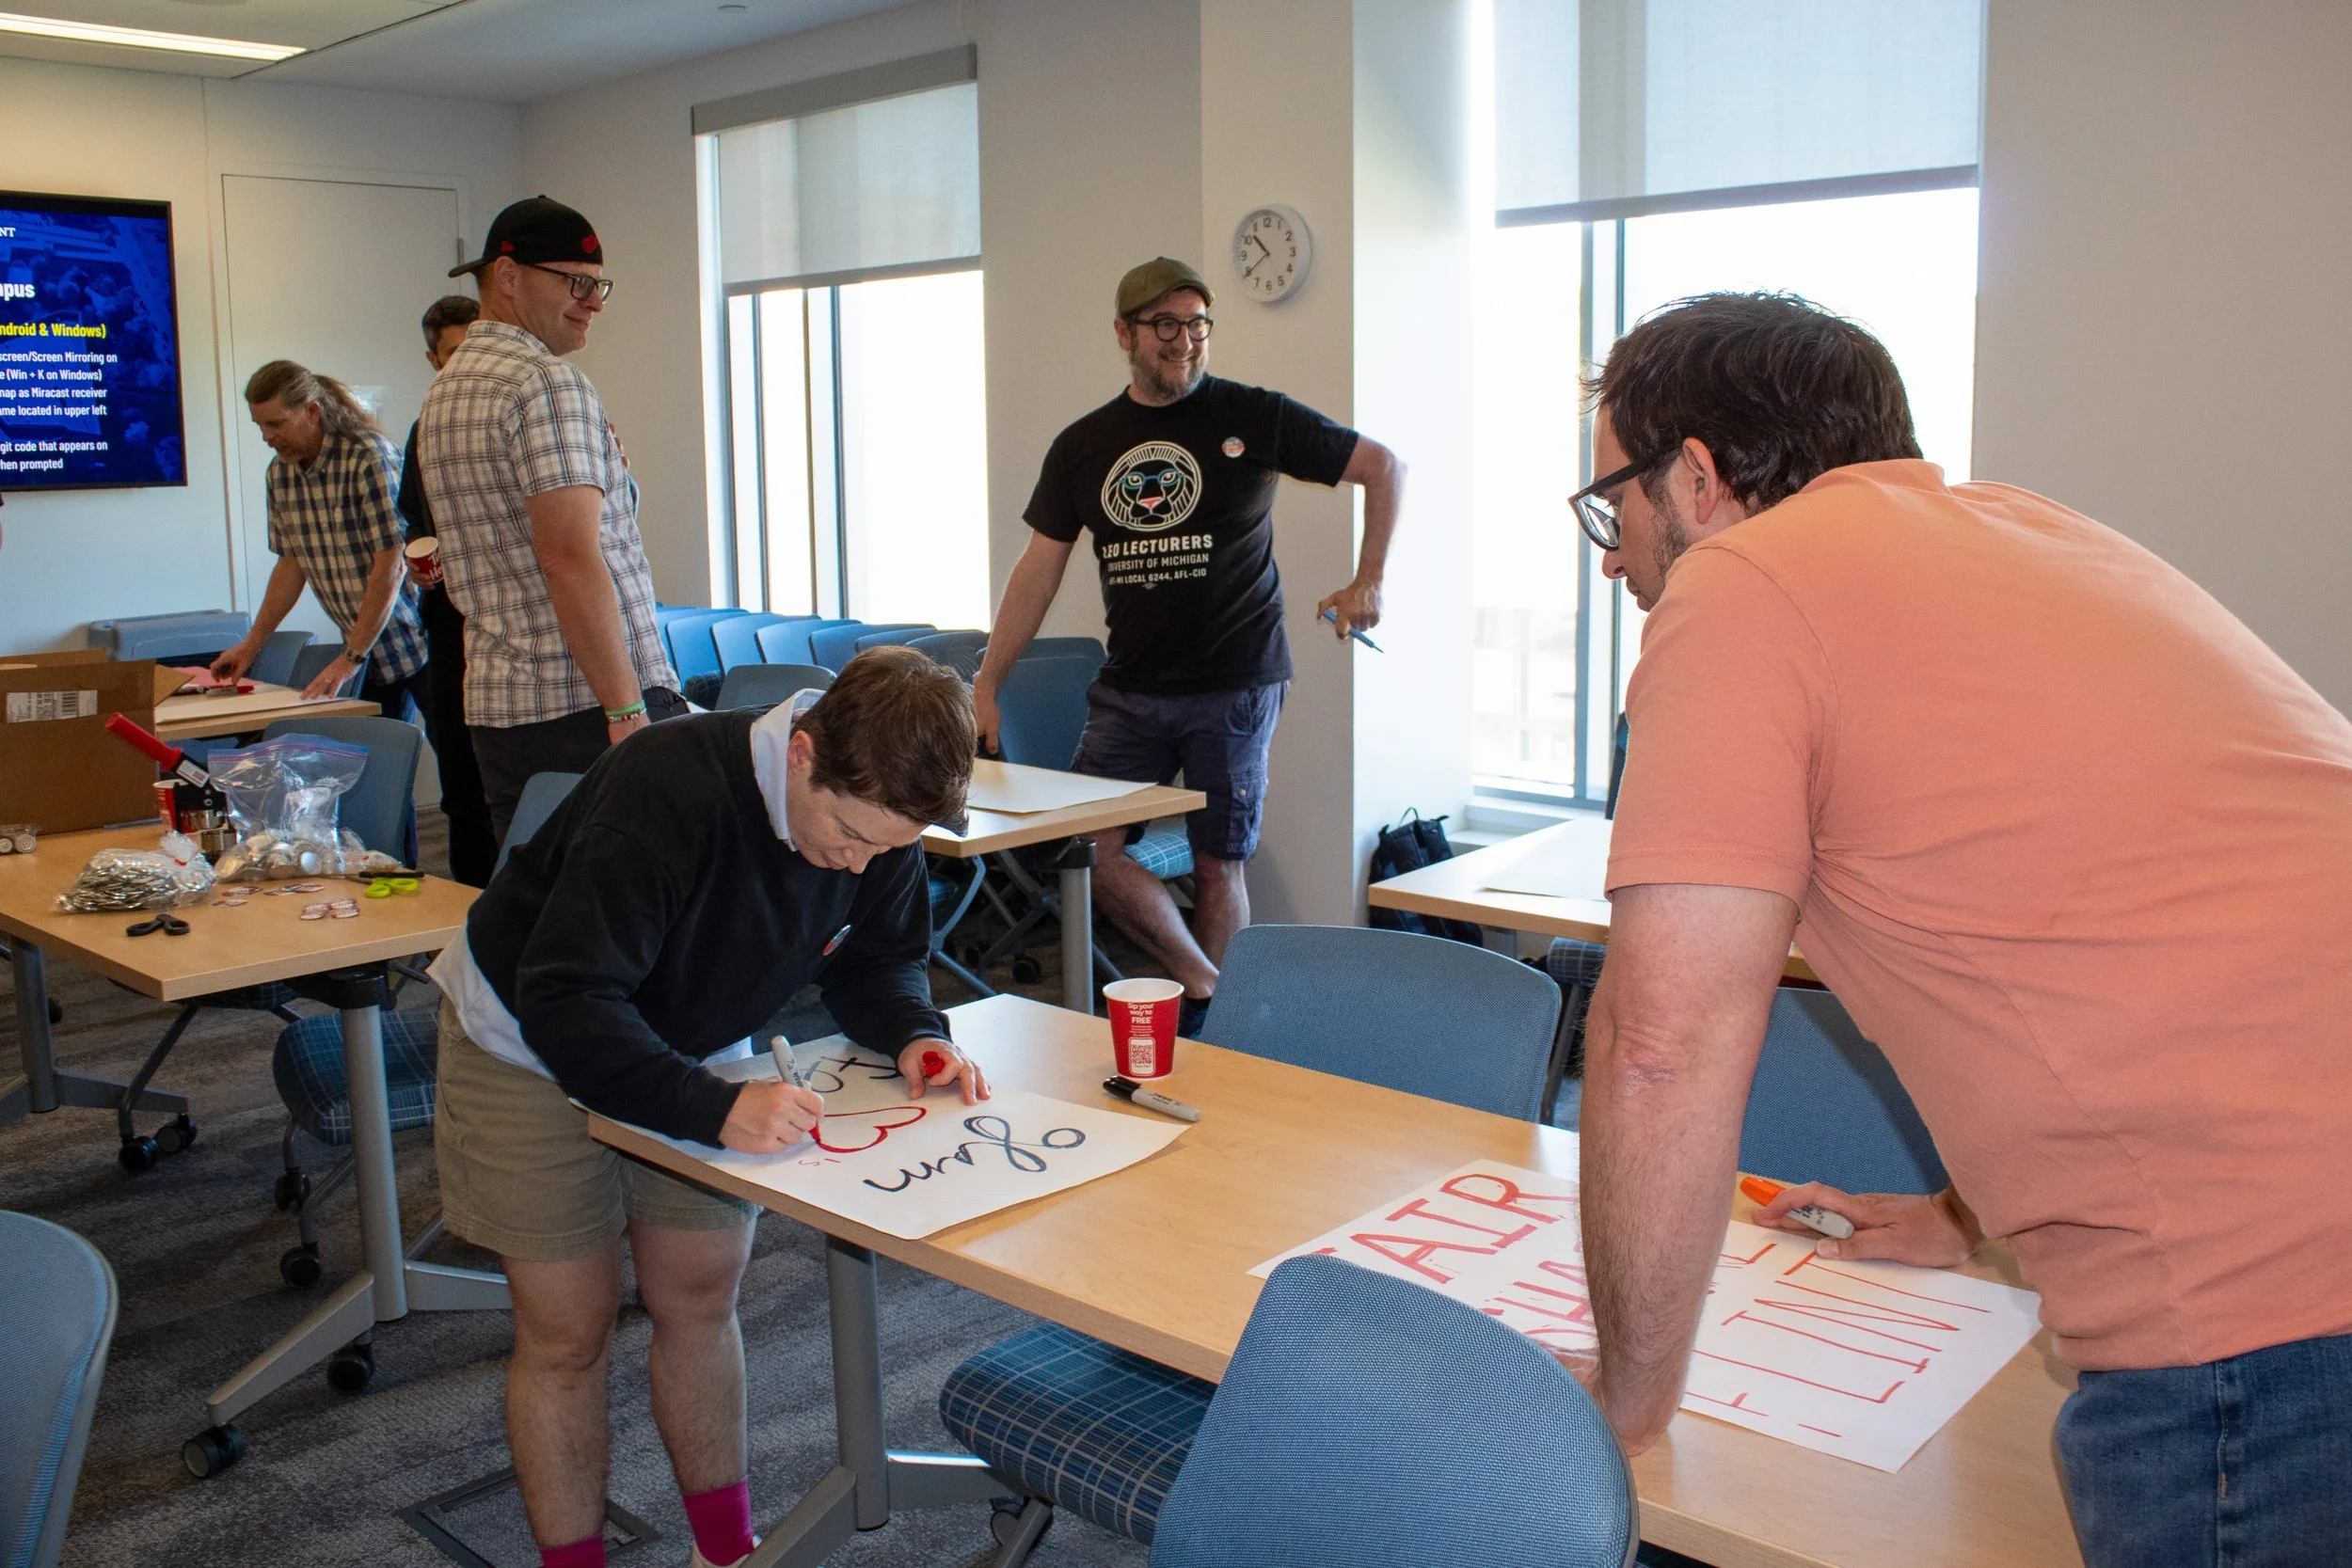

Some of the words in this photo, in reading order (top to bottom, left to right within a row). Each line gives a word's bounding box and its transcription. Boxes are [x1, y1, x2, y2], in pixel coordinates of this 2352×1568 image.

[1263, 216, 1272, 228] 12
[1244, 235, 1252, 245] 10
[1285, 230, 1292, 241] 2
[1241, 250, 1248, 261] 9
[1290, 246, 1296, 258] 3
[1286, 263, 1293, 273] 4
[1254, 277, 1260, 288] 7
[1265, 280, 1272, 291] 6
[1278, 276, 1284, 286] 5
[39, 323, 49, 337] &
[51, 324, 106, 339] Windows)
[65, 351, 104, 365] Mirroring
[105, 354, 118, 363] on
[7, 368, 28, 381] (Win
[38, 369, 45, 380] K
[46, 372, 58, 380] on
[59, 369, 103, 381] Windows)
[18, 389, 30, 398] as
[31, 387, 70, 398] Miracast
[71, 387, 107, 398] receiver
[18, 404, 52, 416] located
[53, 404, 63, 416] in
[64, 406, 91, 418] upper
[91, 404, 107, 416] left
[14, 441, 37, 451] code
[38, 440, 57, 451] that
[58, 441, 95, 453] appears
[96, 441, 108, 451] on
[0, 459, 18, 470] hen
[20, 458, 64, 472] prompted
[1122, 533, 1214, 556] LECTURERS
[1146, 558, 1159, 569] OF
[1161, 552, 1210, 567] MICHIGAN
[1124, 574, 1147, 584] LOCAL
[1148, 571, 1173, 582] 6244,
[1173, 568, 1207, 579] AFL-CIO
[1138, 1003, 1155, 1011] your
[1132, 1016, 1152, 1024] FREE
[1313, 1173, 1578, 1285] AIR
